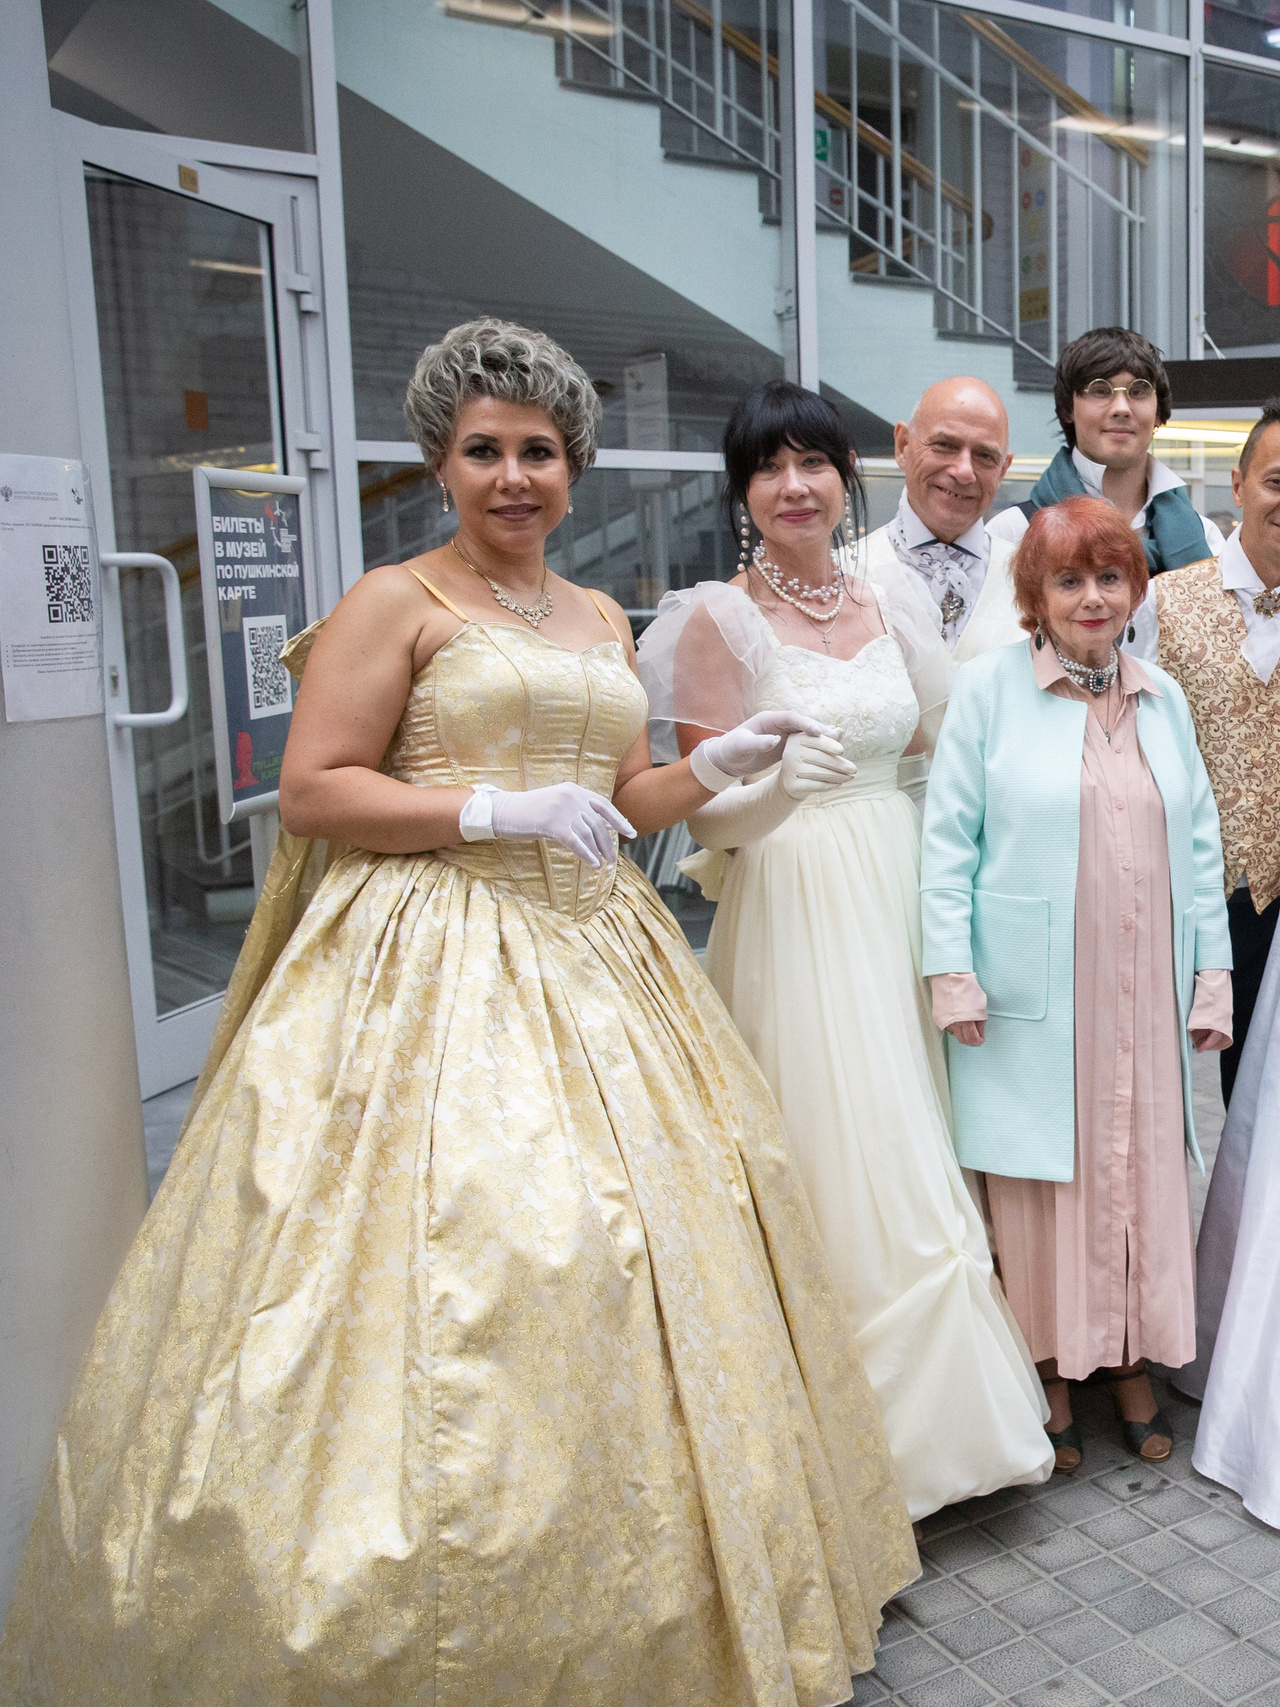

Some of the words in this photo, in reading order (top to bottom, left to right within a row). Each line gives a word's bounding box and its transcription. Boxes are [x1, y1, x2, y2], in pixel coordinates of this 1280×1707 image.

[212, 516, 265, 533] БИЛЕТЫ
[215, 542, 224, 557] В
[226, 538, 267, 559] МУЗЕЙ
[216, 565, 233, 579] ПО
[234, 561, 300, 580] ПУШКИНСКОЙ
[218, 585, 257, 601] КАРТЕ
